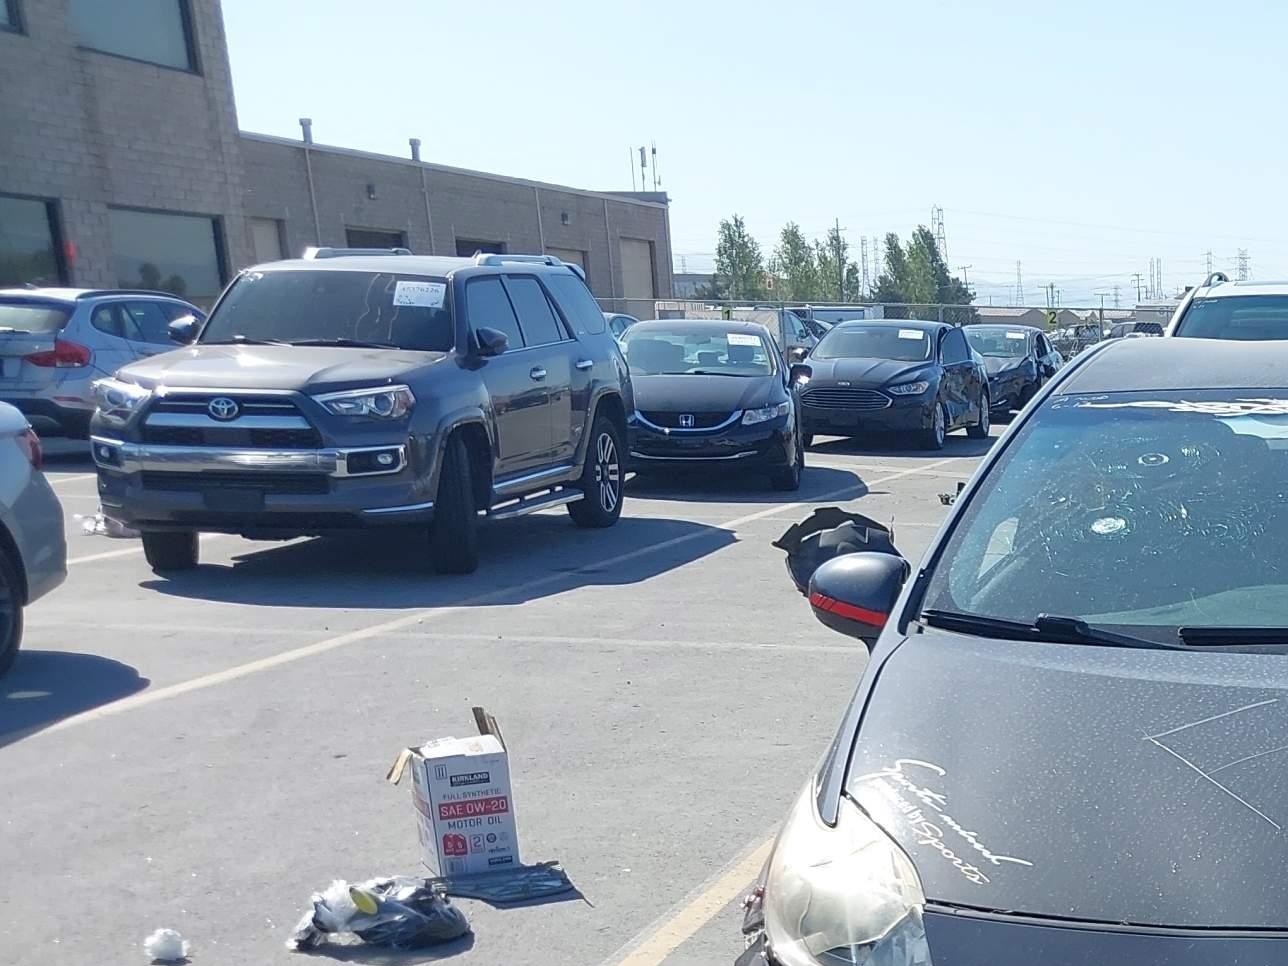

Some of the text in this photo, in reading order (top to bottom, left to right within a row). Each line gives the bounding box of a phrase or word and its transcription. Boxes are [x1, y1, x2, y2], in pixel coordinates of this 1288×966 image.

[725, 309, 731, 320] 1
[1049, 311, 1057, 324] 2
[452, 773, 489, 783] KIRKLAND
[463, 787, 499, 799] SYNTHETIC
[441, 804, 464, 817] SAE
[466, 800, 506, 813] 0W-20
[448, 815, 502, 830] MOTOR OIL
[473, 836, 481, 848] 2
[911, 822, 991, 884] Sports
